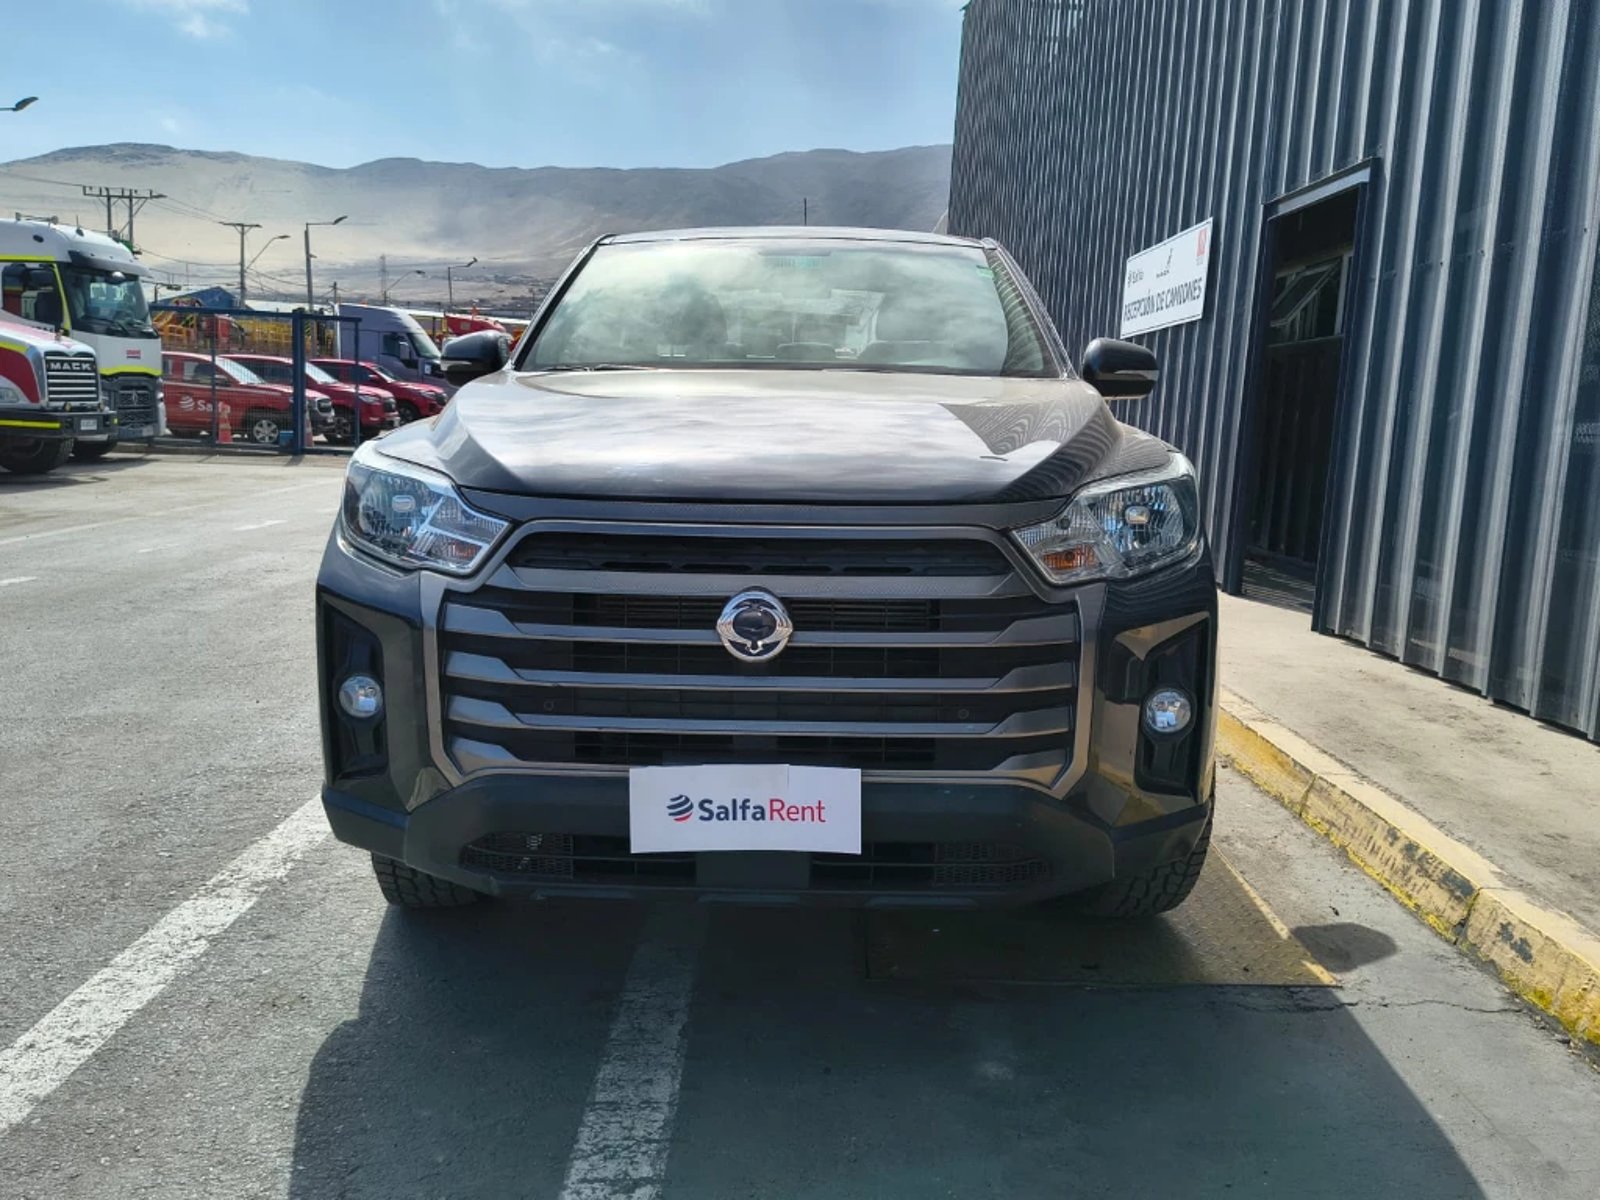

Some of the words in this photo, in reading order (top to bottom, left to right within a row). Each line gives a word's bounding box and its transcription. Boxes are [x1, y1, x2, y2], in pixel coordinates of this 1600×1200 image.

[1156, 290, 1165, 312] DE
[1165, 277, 1202, 308] CAMIONES
[50, 362, 92, 371] MACK
[197, 399, 231, 413] Safa
[698, 798, 826, 822] SalfaRent
